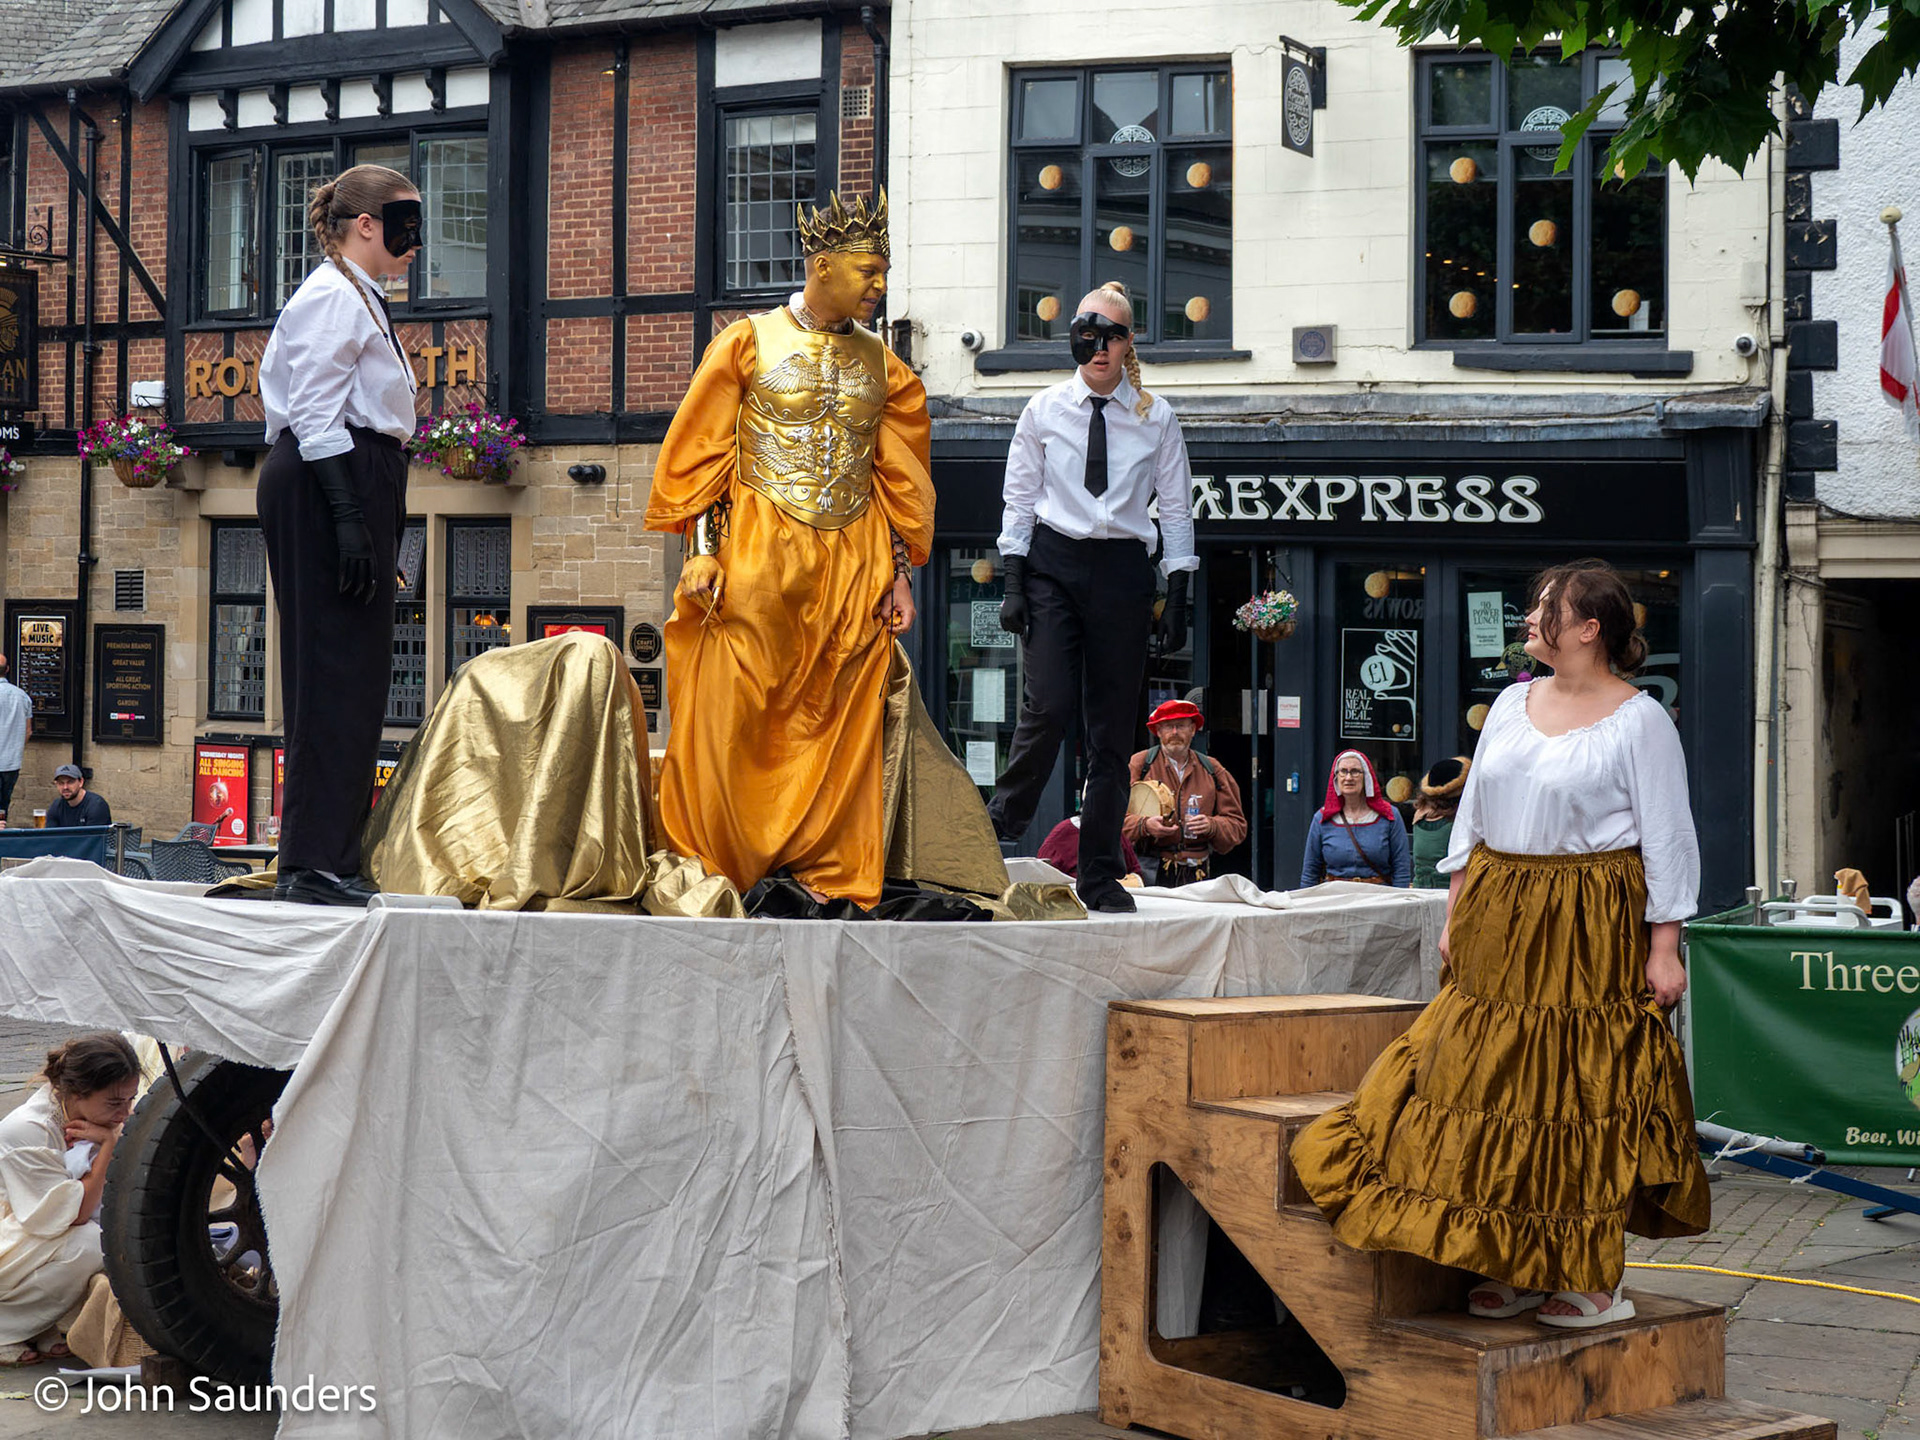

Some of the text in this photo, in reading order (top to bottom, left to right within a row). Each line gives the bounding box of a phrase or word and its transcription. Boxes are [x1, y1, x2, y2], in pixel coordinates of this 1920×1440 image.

[189, 345, 477, 399] RO TH
[1150, 475, 1544, 523] AEXPRESS
[1472, 609, 1499, 617] POWER
[1474, 616, 1499, 625] LUNCH
[33, 623, 50, 632] LIVE
[28, 634, 54, 643] MUSIC
[1368, 661, 1389, 685] £1
[1345, 688, 1372, 700] REAL.
[199, 758, 245, 769] ALL SINGING
[198, 767, 245, 777] ALL DANCING
[1790, 951, 1920, 993] Three
[1845, 1126, 1893, 1146] Beer,
